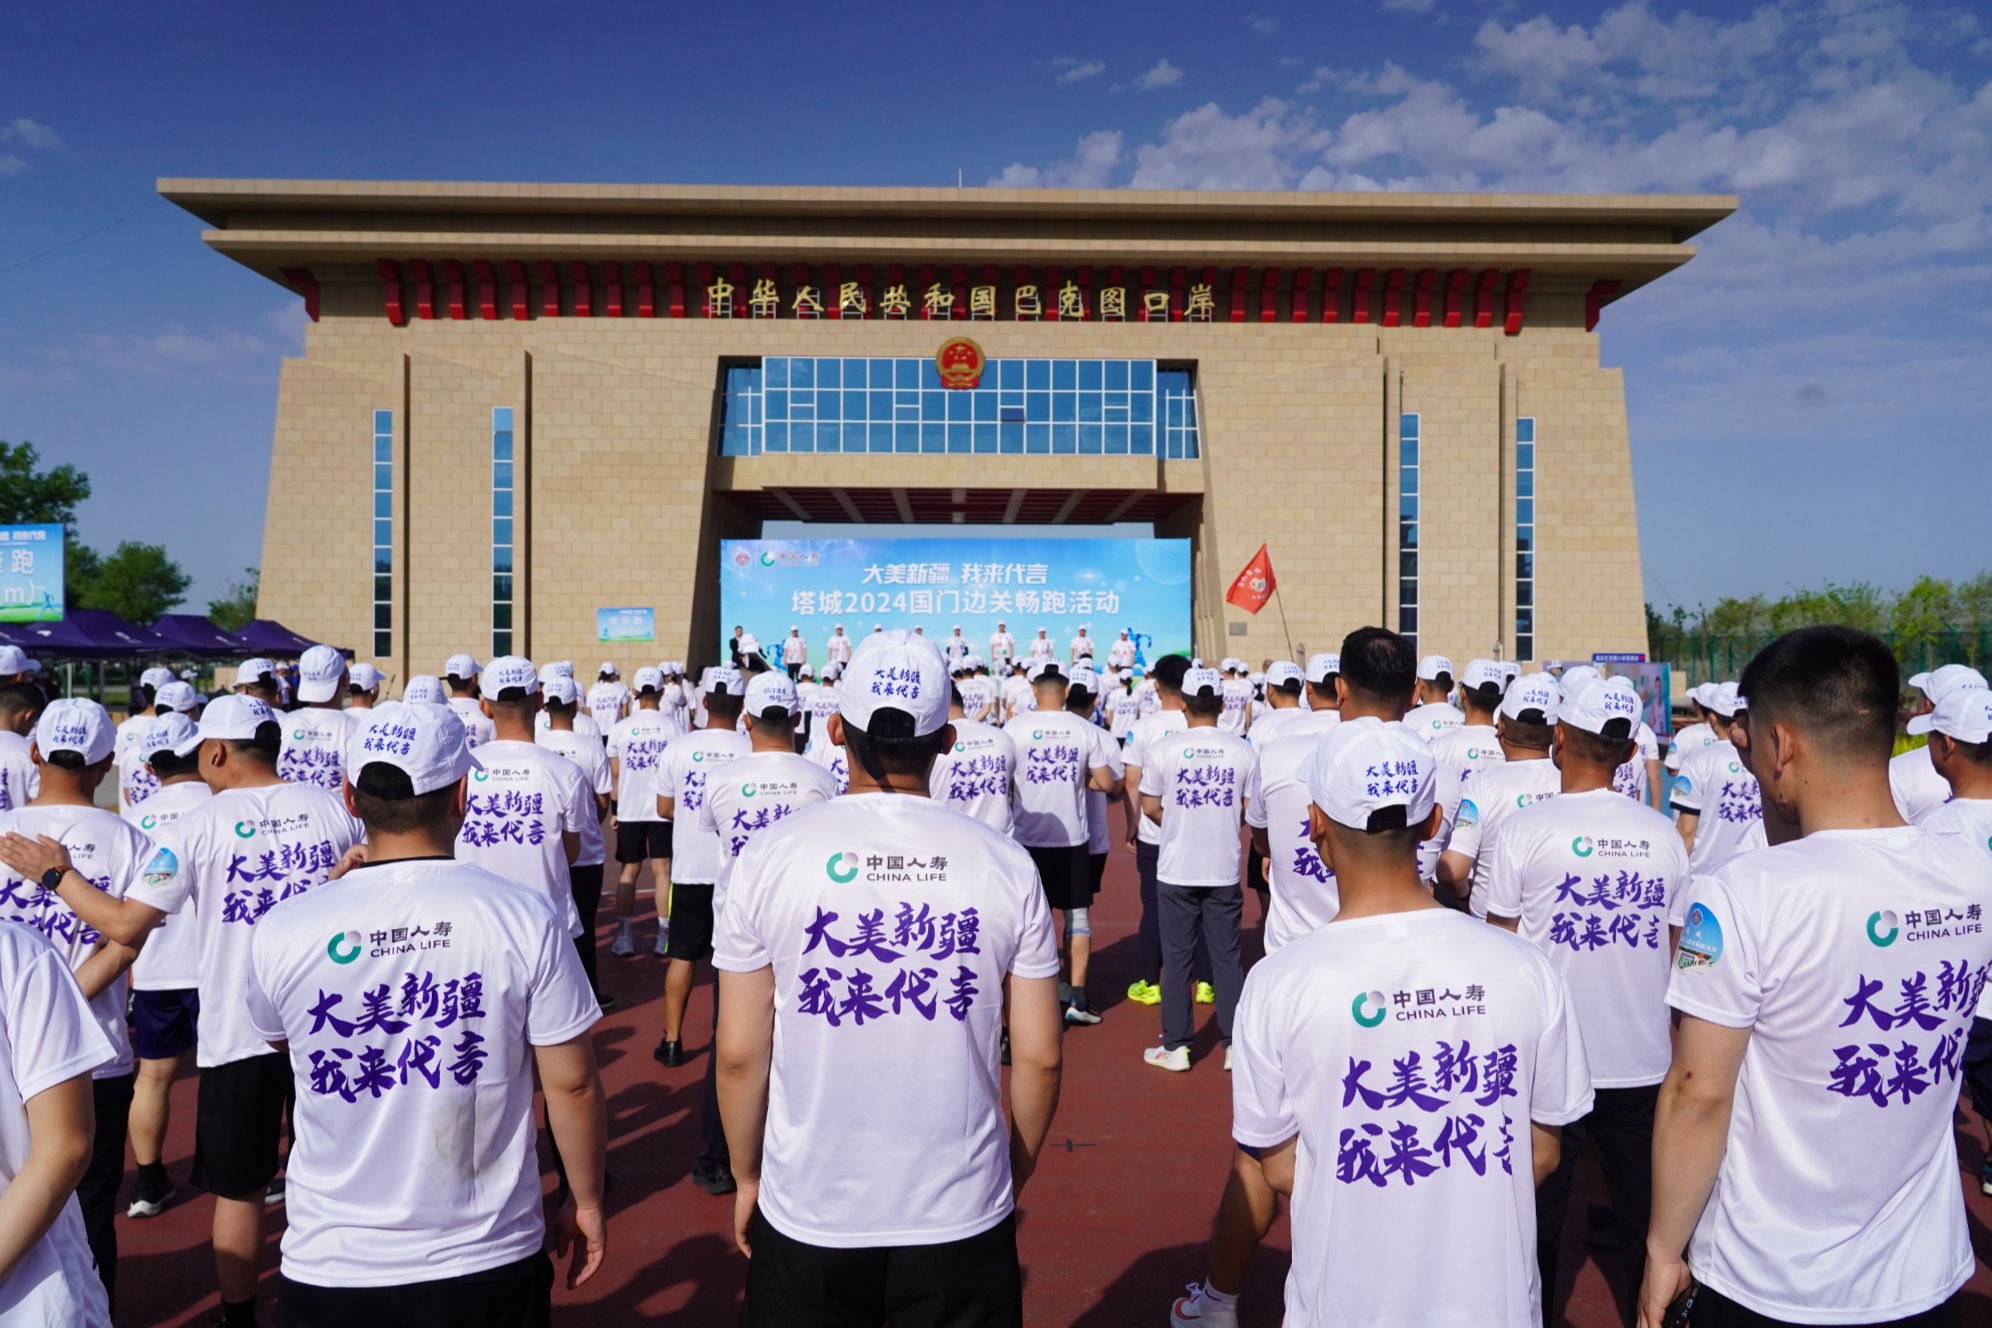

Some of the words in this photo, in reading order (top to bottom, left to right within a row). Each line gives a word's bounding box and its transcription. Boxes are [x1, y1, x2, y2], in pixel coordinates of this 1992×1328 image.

[707, 277, 1215, 320] 中华人民共和国巴克图口岸
[861, 562, 949, 585] 大美新疆
[961, 562, 1048, 585] 我来代言
[791, 590, 1120, 616] 塔城2024国门边关畅跑活动
[874, 667, 921, 685] 大美新疆
[870, 681, 919, 699] 我来代言
[369, 723, 416, 741] 大美新疆
[283, 747, 340, 768] 大美新疆
[363, 738, 410, 755] 我来代言
[950, 755, 1007, 777] 大美新疆
[1177, 765, 1235, 787] 大美新疆
[1366, 760, 1419, 778] 大美新疆
[760, 782, 797, 790] 中国人寿
[948, 775, 1007, 802] 我来代言
[1367, 778, 1418, 797] 我来代言
[467, 790, 544, 818] 大美新疆
[1176, 787, 1233, 809] 我来代言
[260, 814, 308, 828] 中国人寿
[731, 803, 800, 831] 大美新
[262, 827, 287, 836] CHINA
[290, 822, 310, 831] LIFE
[463, 820, 546, 848] 我来代言
[1598, 839, 1650, 850] 中国人寿
[226, 840, 336, 883] 大美新疆
[866, 855, 948, 871] 中国人寿
[866, 873, 911, 882] CHINA
[916, 873, 947, 882] LIFE
[1554, 870, 1666, 910] 大美新疆
[1905, 903, 1982, 929] 中国人寿
[370, 921, 453, 946] 中国人寿
[802, 901, 981, 963] 大美新疆
[1550, 912, 1660, 952] 我来代言
[1906, 928, 1951, 942] CHINA
[1955, 924, 1983, 936] LIFE
[370, 944, 415, 958] CHINA
[420, 939, 451, 950] LIFE
[307, 970, 487, 1038] 大美新疆
[798, 965, 979, 1027] 我来代言
[1393, 984, 1486, 1009] 中国人寿
[1395, 1008, 1447, 1021] CHINA
[1452, 1005, 1486, 1017] LIFE
[308, 1030, 489, 1104] 我来代言
[1342, 1039, 1518, 1113] 大美新疆
[1827, 1027, 1970, 1108] 我来代
